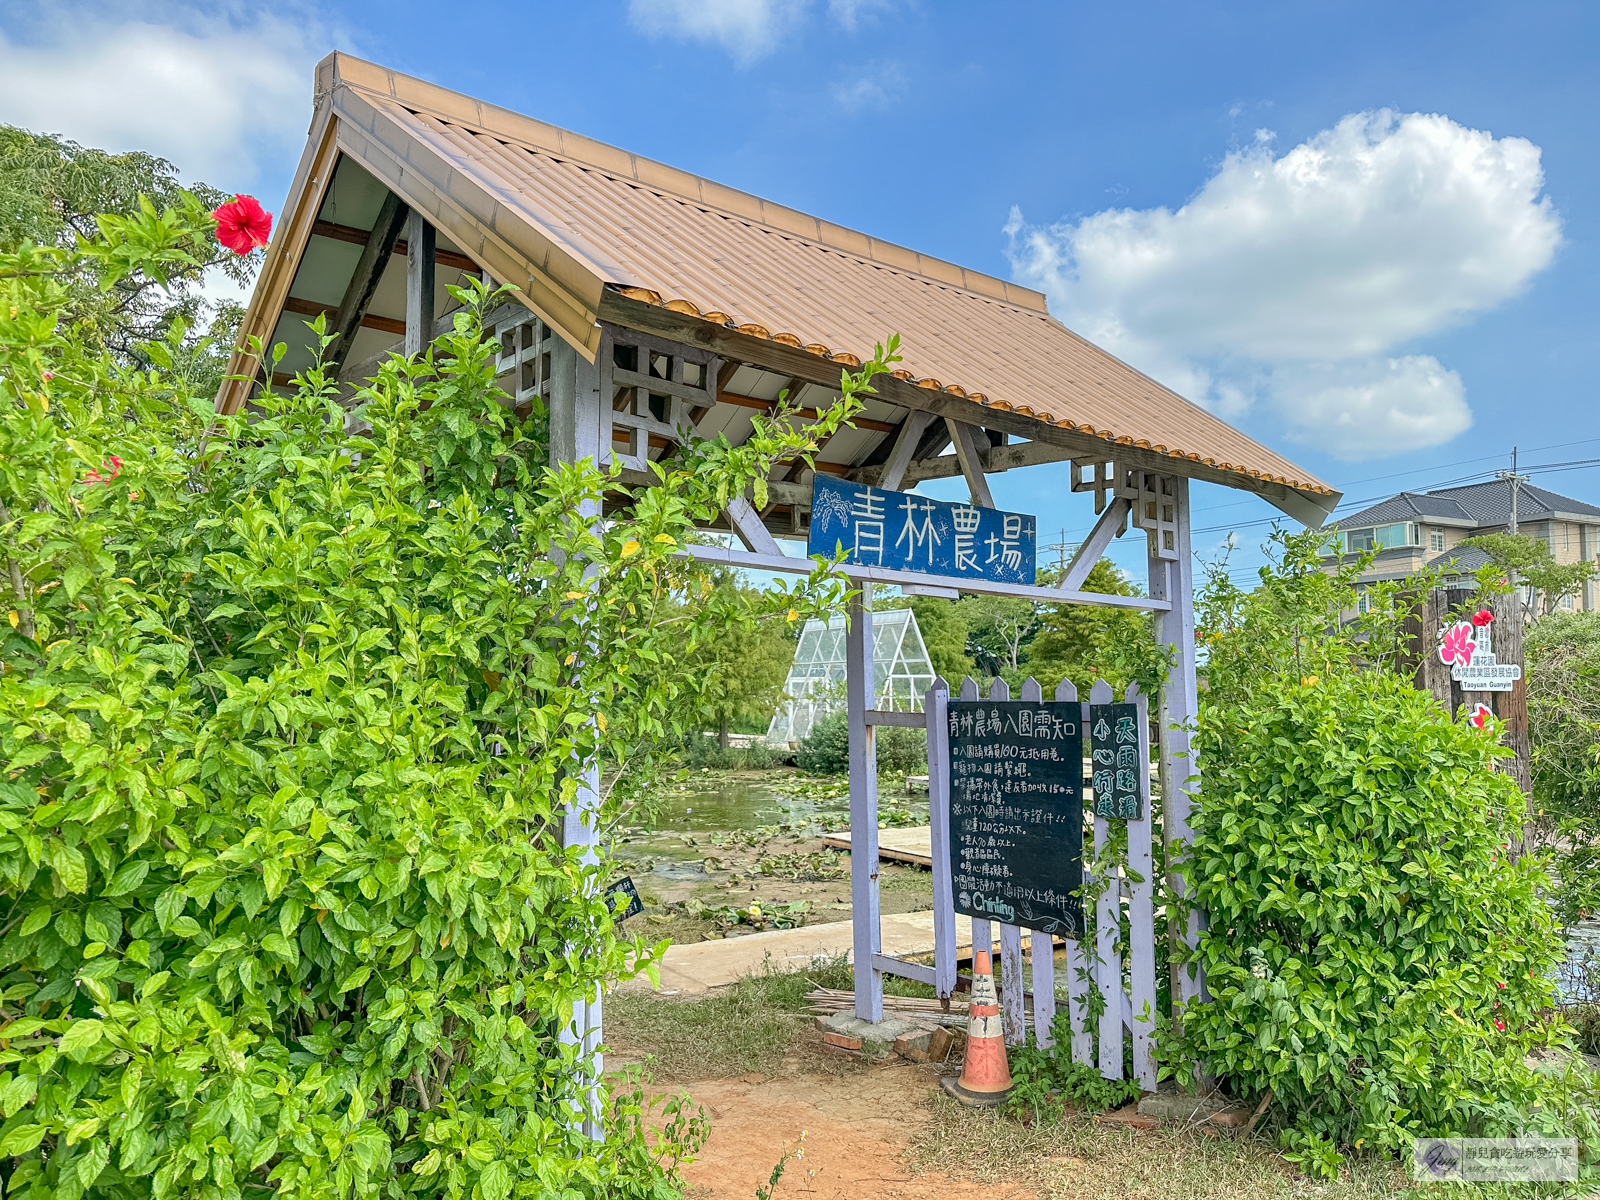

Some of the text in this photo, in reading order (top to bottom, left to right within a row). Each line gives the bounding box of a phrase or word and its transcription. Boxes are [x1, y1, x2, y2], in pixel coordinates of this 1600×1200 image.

[851, 486, 1021, 573] 青林農場
[1464, 681, 1511, 689] Taoyuan Guanyin
[1473, 656, 1494, 666] 蓮花園
[949, 707, 1076, 740] 青林農場入園需知
[1093, 718, 1115, 817] 小心行走
[1115, 717, 1137, 818] 天雨路滑
